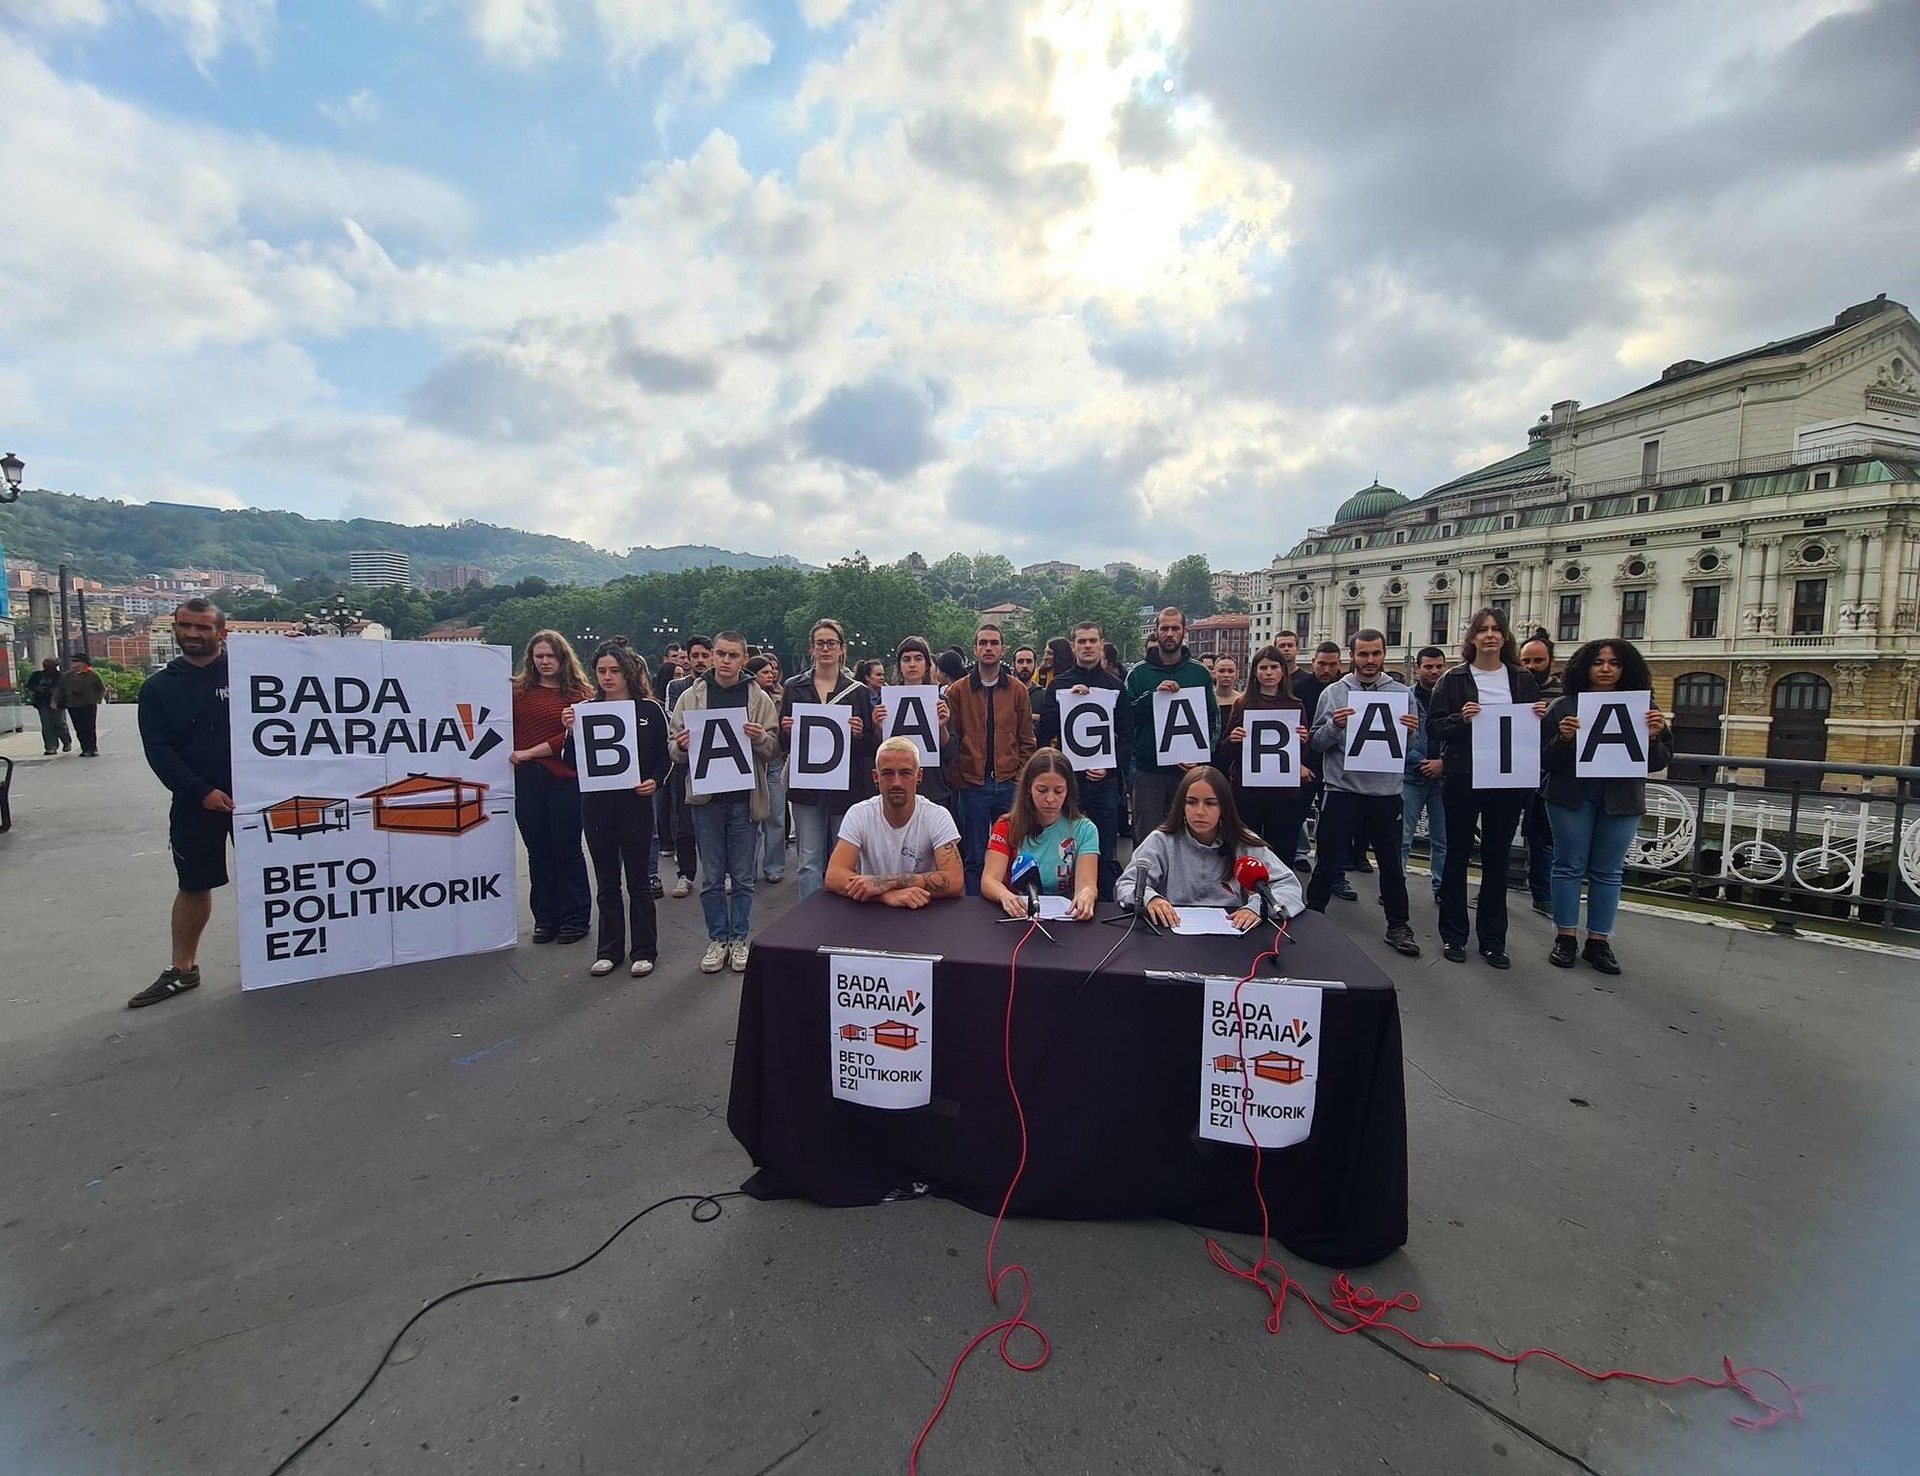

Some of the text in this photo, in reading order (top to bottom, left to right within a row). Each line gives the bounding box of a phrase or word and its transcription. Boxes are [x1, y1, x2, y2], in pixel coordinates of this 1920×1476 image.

[250, 676, 411, 714] BADA
[252, 718, 467, 757] GARAIA
[889, 697, 937, 753] A
[1063, 702, 1112, 758] G
[1159, 699, 1208, 753] A
[1347, 702, 1404, 759] A
[1580, 703, 1645, 763] A
[581, 713, 631, 778] B
[694, 719, 752, 780] A
[797, 716, 845, 774] D
[1250, 720, 1291, 774] R
[1499, 716, 1512, 774] I
[262, 857, 377, 895] BETO
[263, 873, 502, 929] POLITIKORIK
[266, 926, 327, 962] EZ!
[837, 973, 890, 993] BADA
[837, 991, 910, 1012] GARAIA
[1212, 1000, 1273, 1022] BADA
[1211, 1019, 1296, 1043] GARAIA
[839, 1050, 875, 1066] BETO
[839, 1063, 923, 1083] POLITIKORIK
[839, 1076, 858, 1091] EZ!
[1211, 1083, 1255, 1101] BETO
[1210, 1098, 1306, 1119] POLTIKORIK
[1210, 1112, 1233, 1129] EZ!
